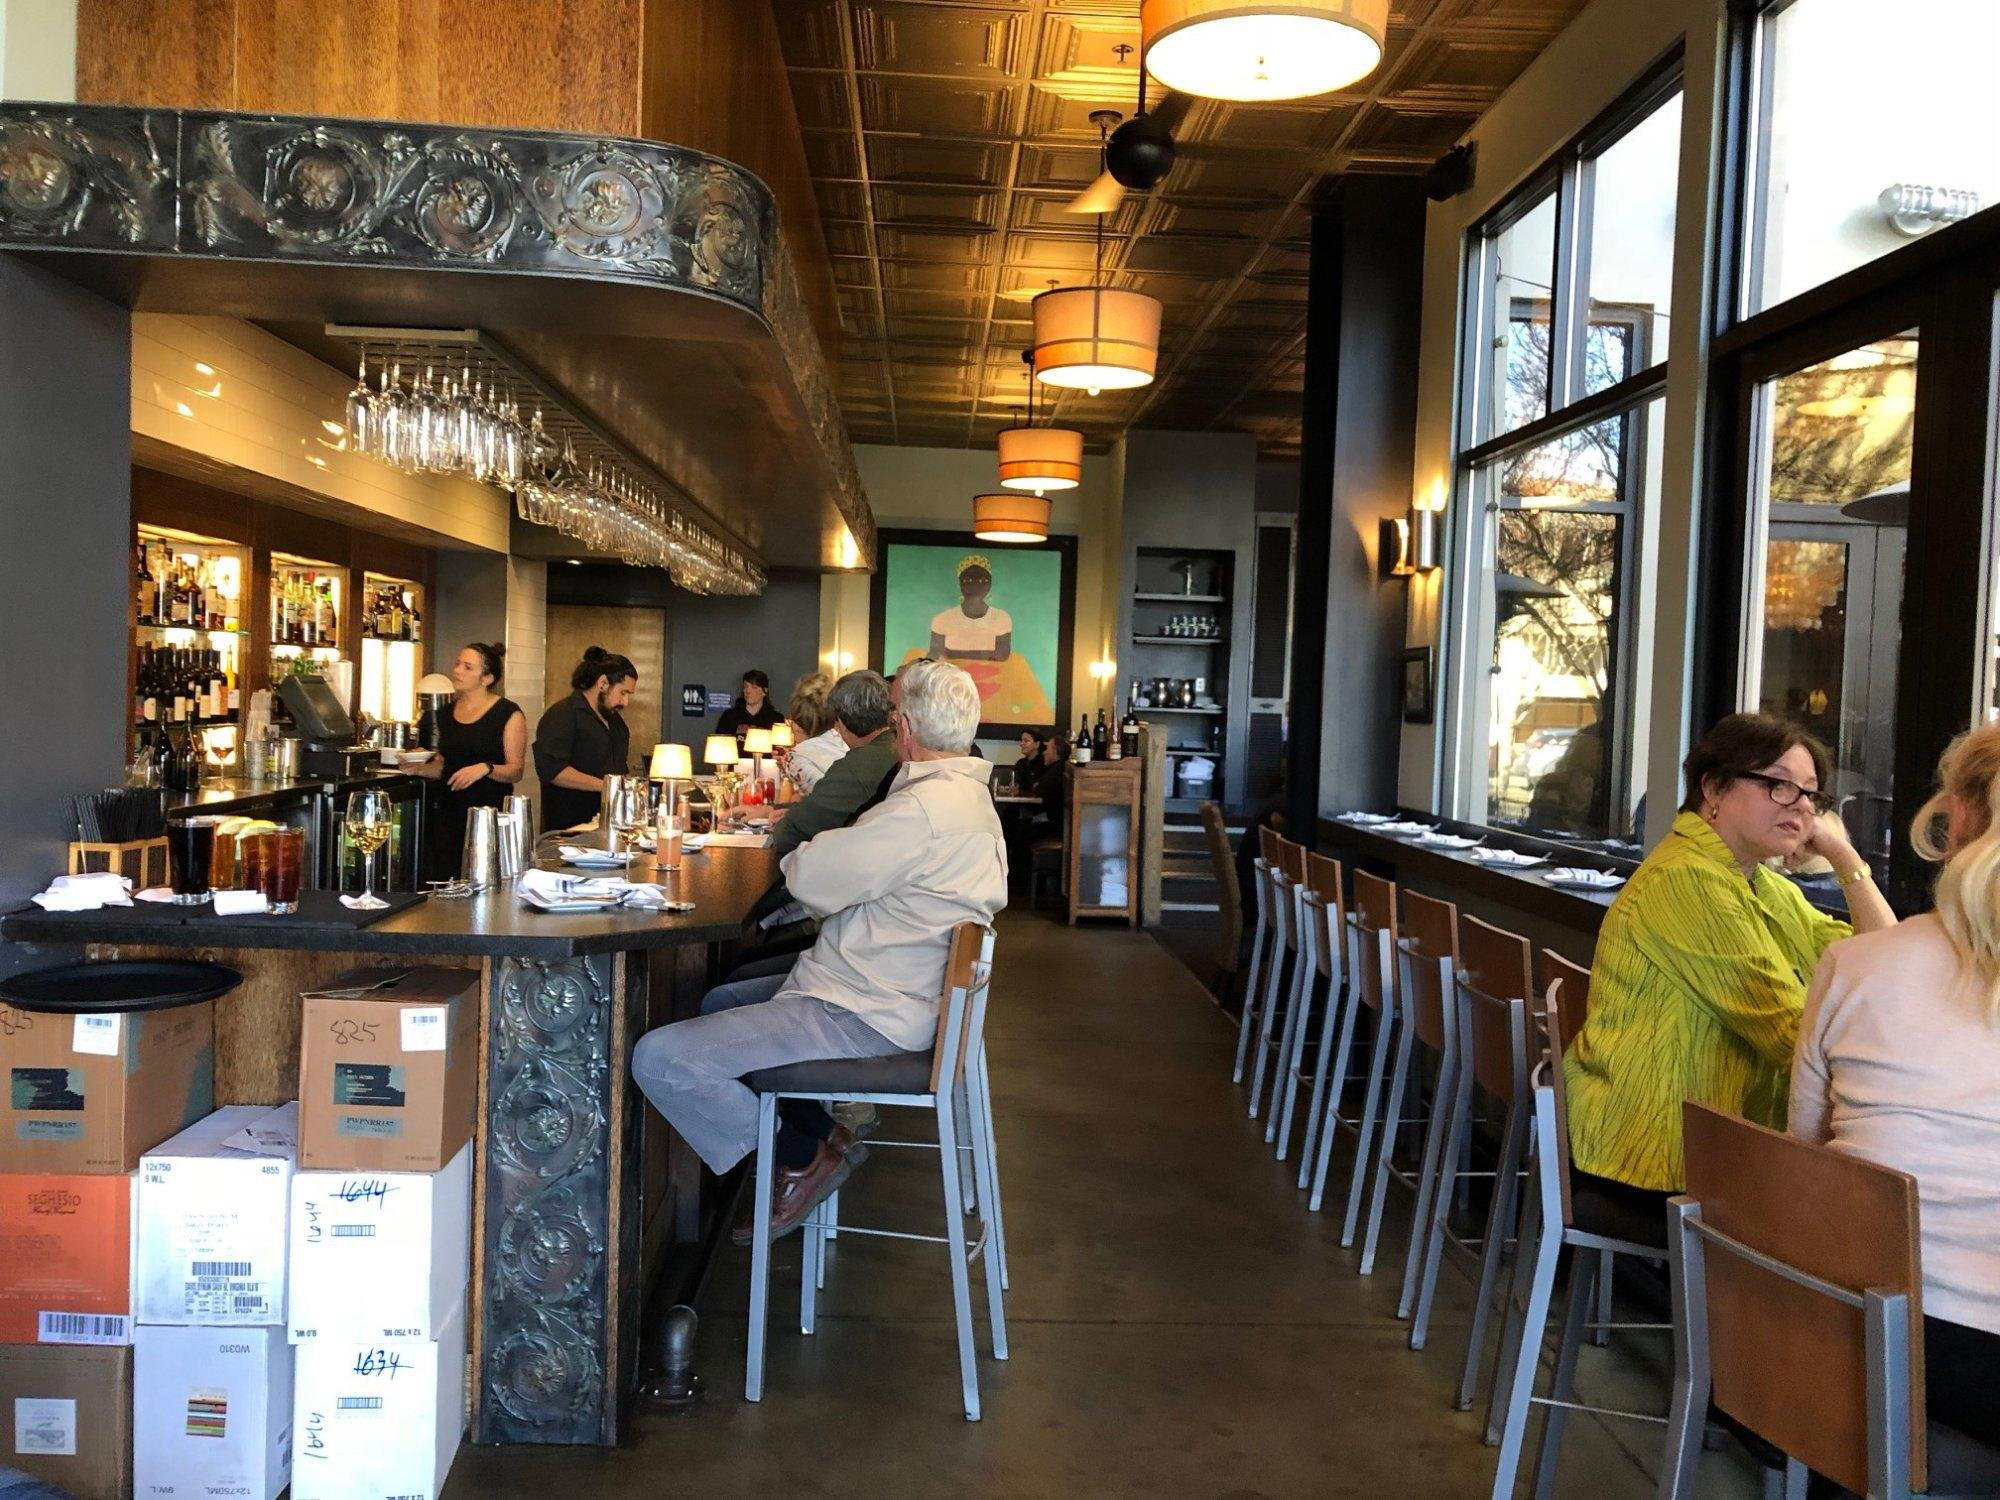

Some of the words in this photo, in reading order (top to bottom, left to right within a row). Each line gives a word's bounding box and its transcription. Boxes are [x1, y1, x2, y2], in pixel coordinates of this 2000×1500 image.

[330, 1020, 380, 1045] 825
[145, 1163, 172, 1172] 12x750
[354, 1348, 401, 1380] 1634
